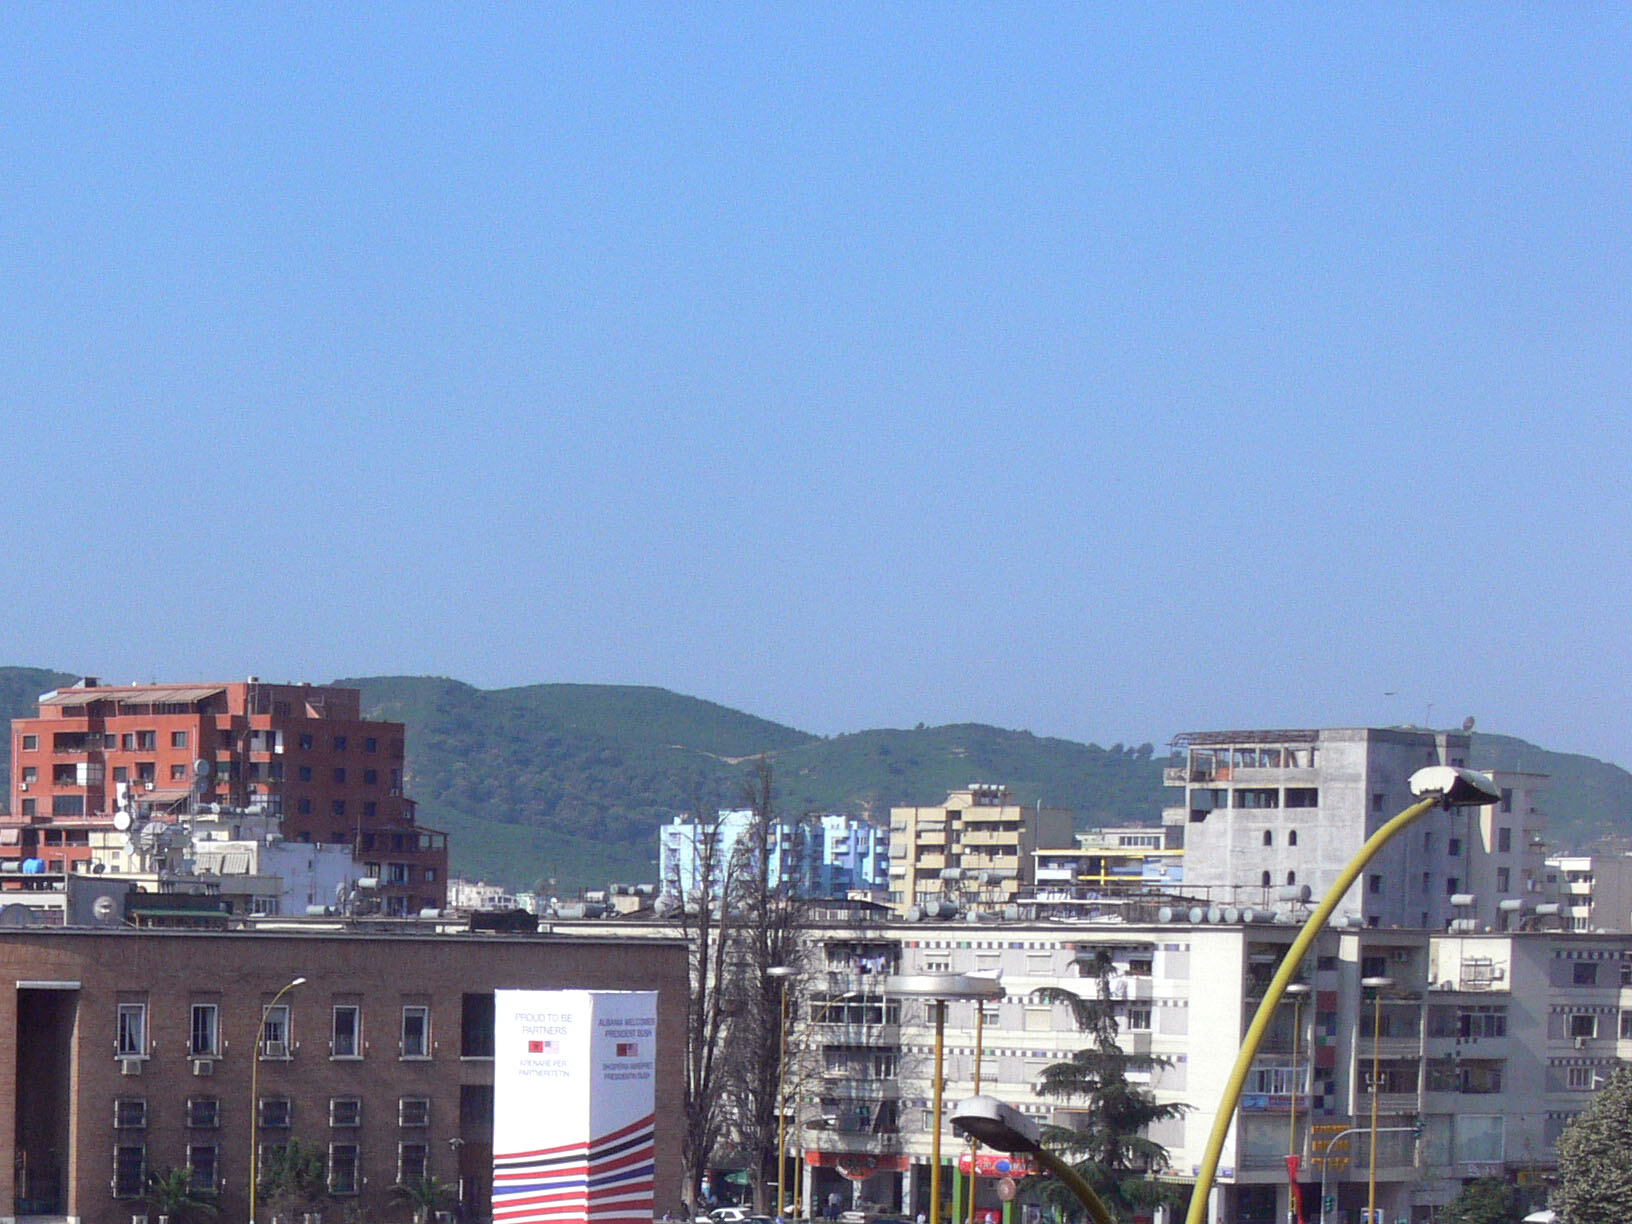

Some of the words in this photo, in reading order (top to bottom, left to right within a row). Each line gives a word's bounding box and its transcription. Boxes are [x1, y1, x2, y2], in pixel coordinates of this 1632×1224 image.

[515, 1013, 545, 1023] PROUD
[547, 1013, 559, 1023] TO
[560, 1013, 573, 1023] BE
[522, 1025, 568, 1036] PARTNERS
